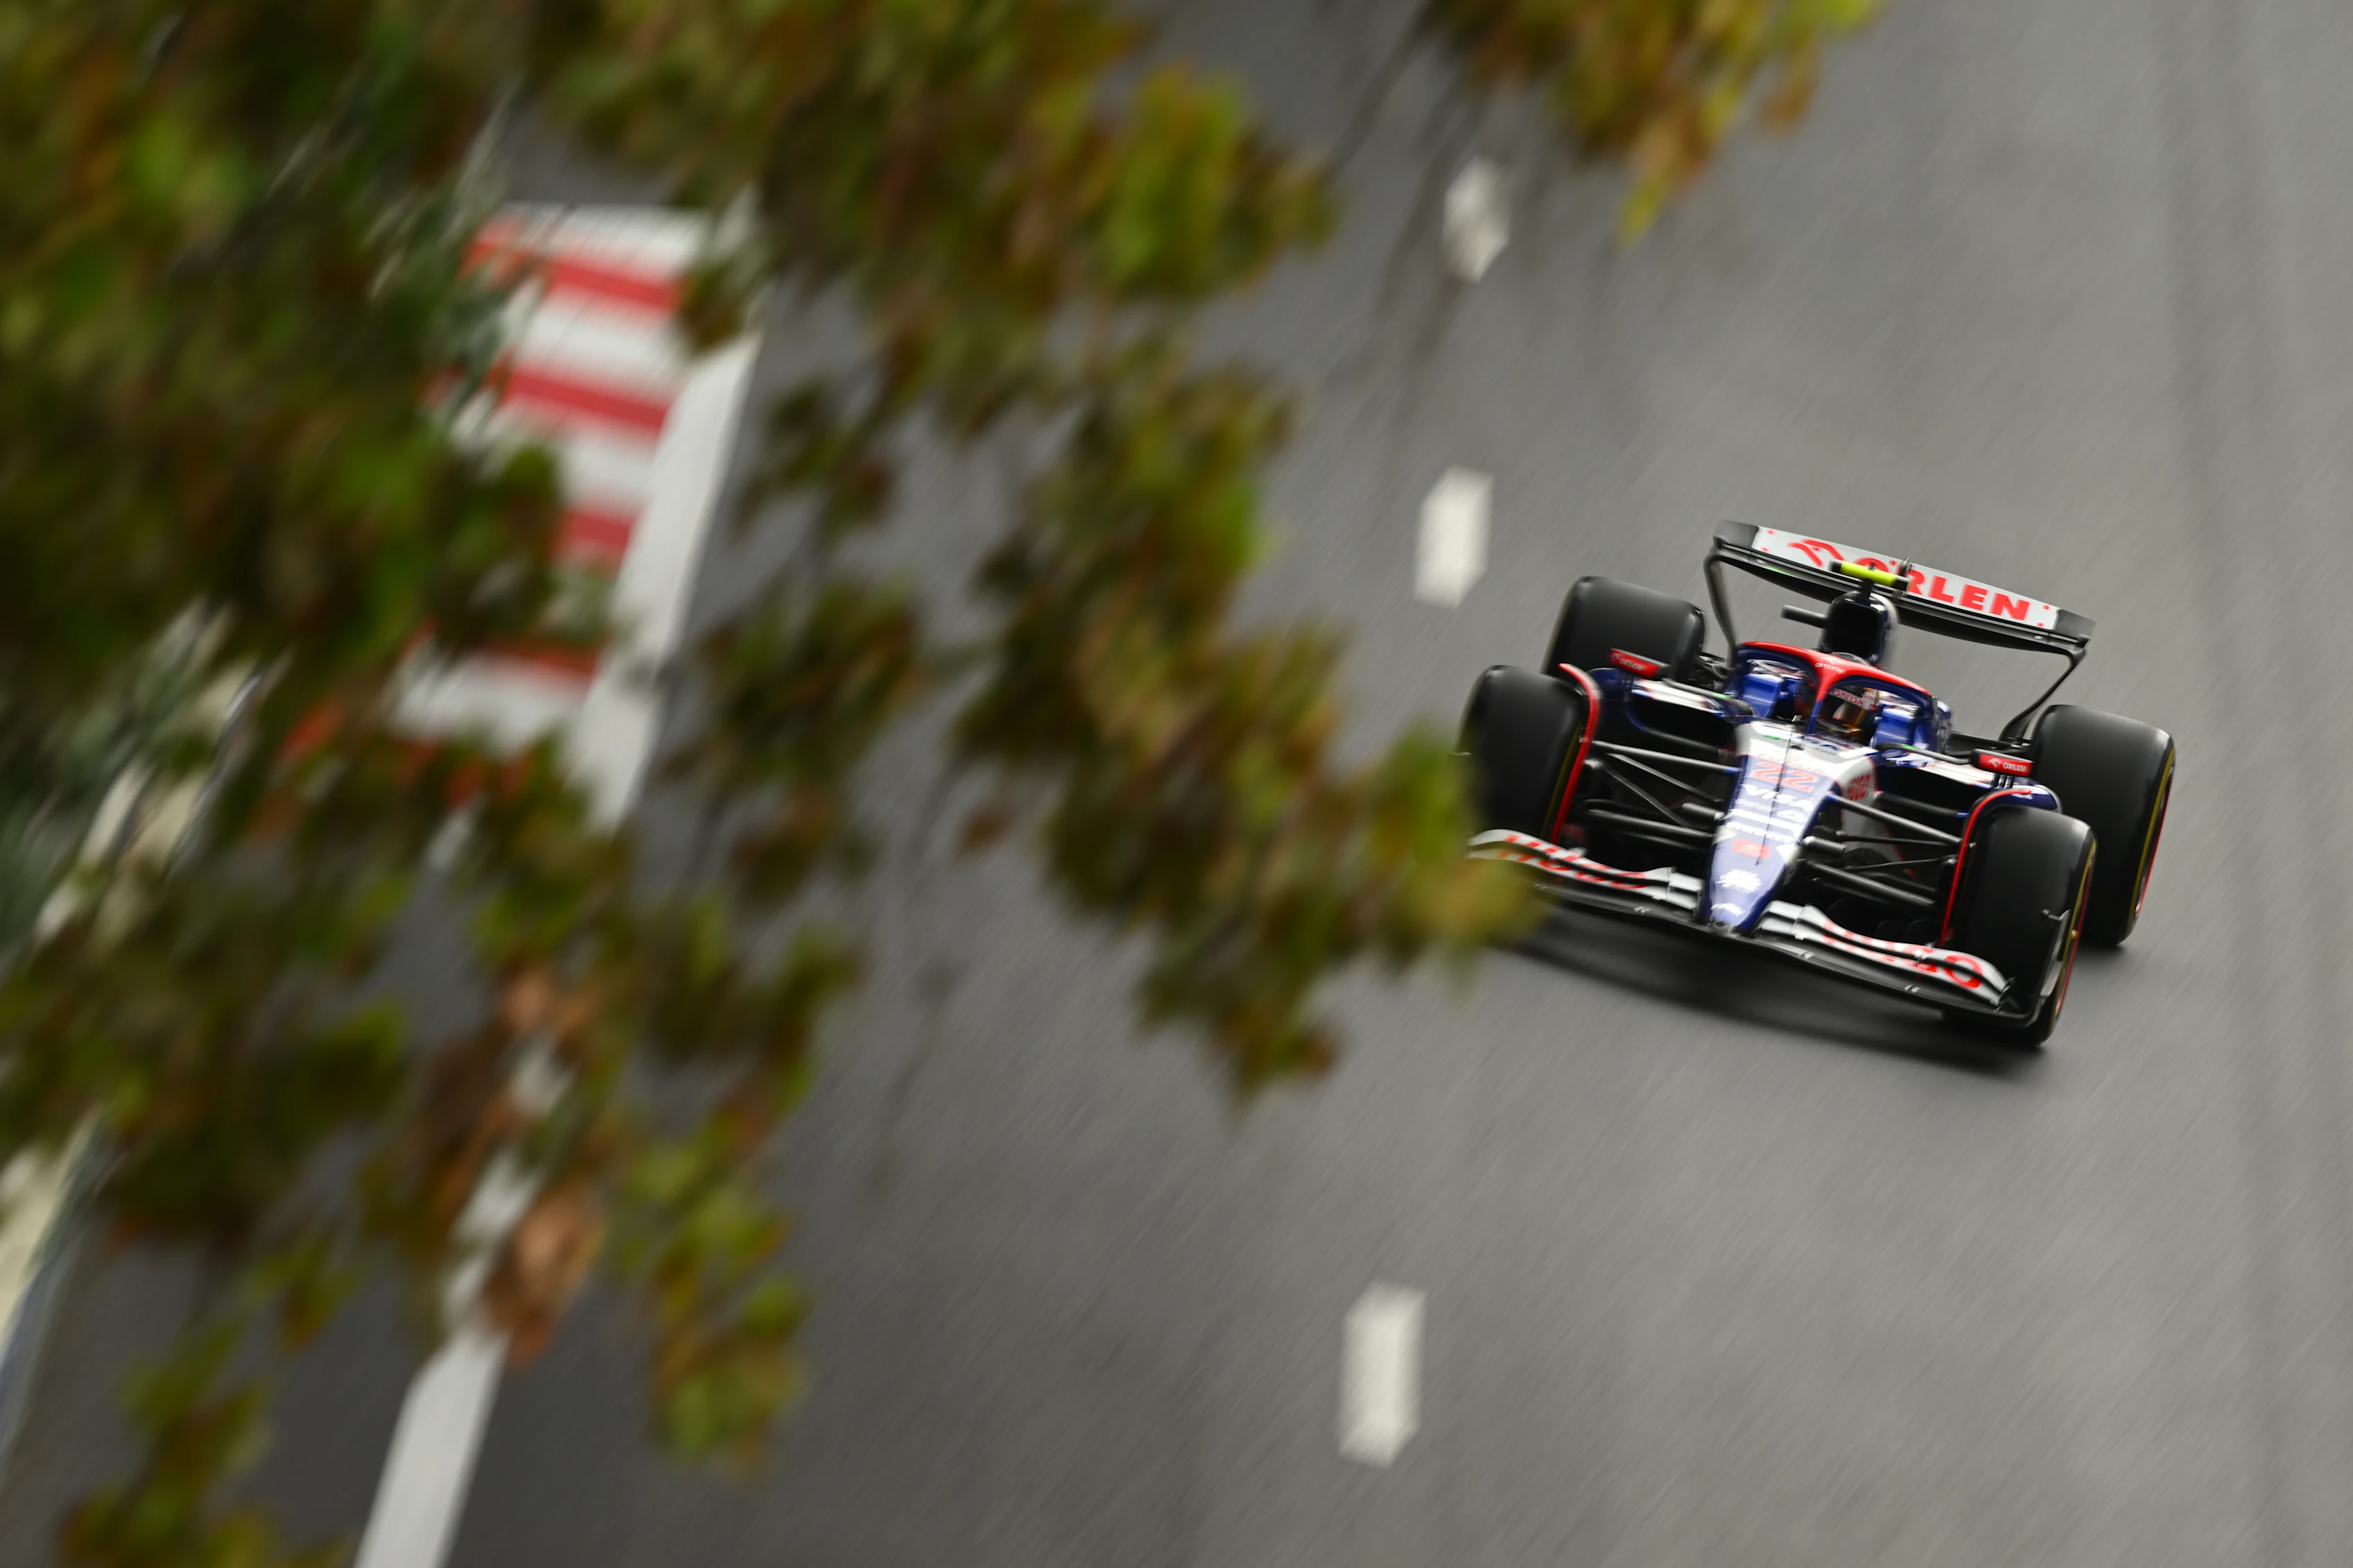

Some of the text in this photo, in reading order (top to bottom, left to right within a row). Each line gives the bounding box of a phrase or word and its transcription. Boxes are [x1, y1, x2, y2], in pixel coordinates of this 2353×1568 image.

[1829, 689, 1865, 707] ONDA
[1752, 761, 1817, 793] 22
[2003, 762, 2026, 773] ORLEN
[1740, 784, 1814, 812] VISA
[1847, 773, 1870, 801] HUGO
